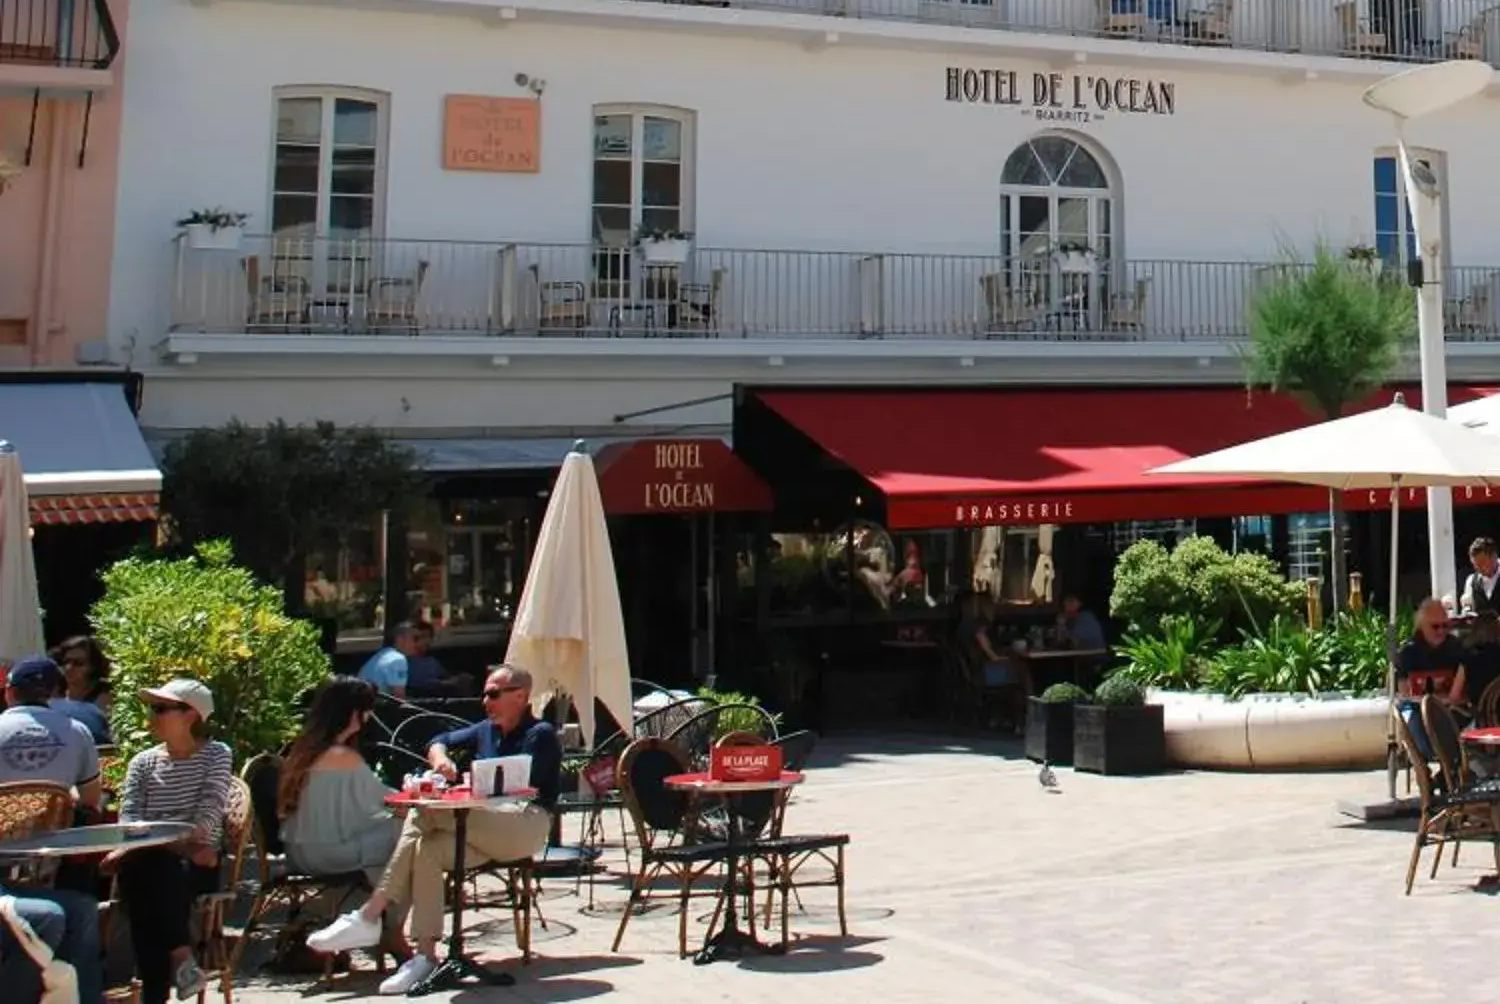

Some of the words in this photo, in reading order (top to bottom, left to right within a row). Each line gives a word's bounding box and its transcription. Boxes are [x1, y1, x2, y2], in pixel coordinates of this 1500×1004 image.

[945, 67, 1022, 105] HOTEL
[1032, 72, 1063, 107] DE
[1073, 75, 1175, 115] L'OCEAN
[1035, 109, 1090, 122] BIARRITZ
[655, 444, 703, 469] HOTEL
[644, 483, 715, 508] L'OCEAN
[955, 502, 1073, 521] BRASSERIE
[722, 756, 732, 767] DE
[733, 756, 743, 766] LA
[744, 755, 769, 766] PLACE
